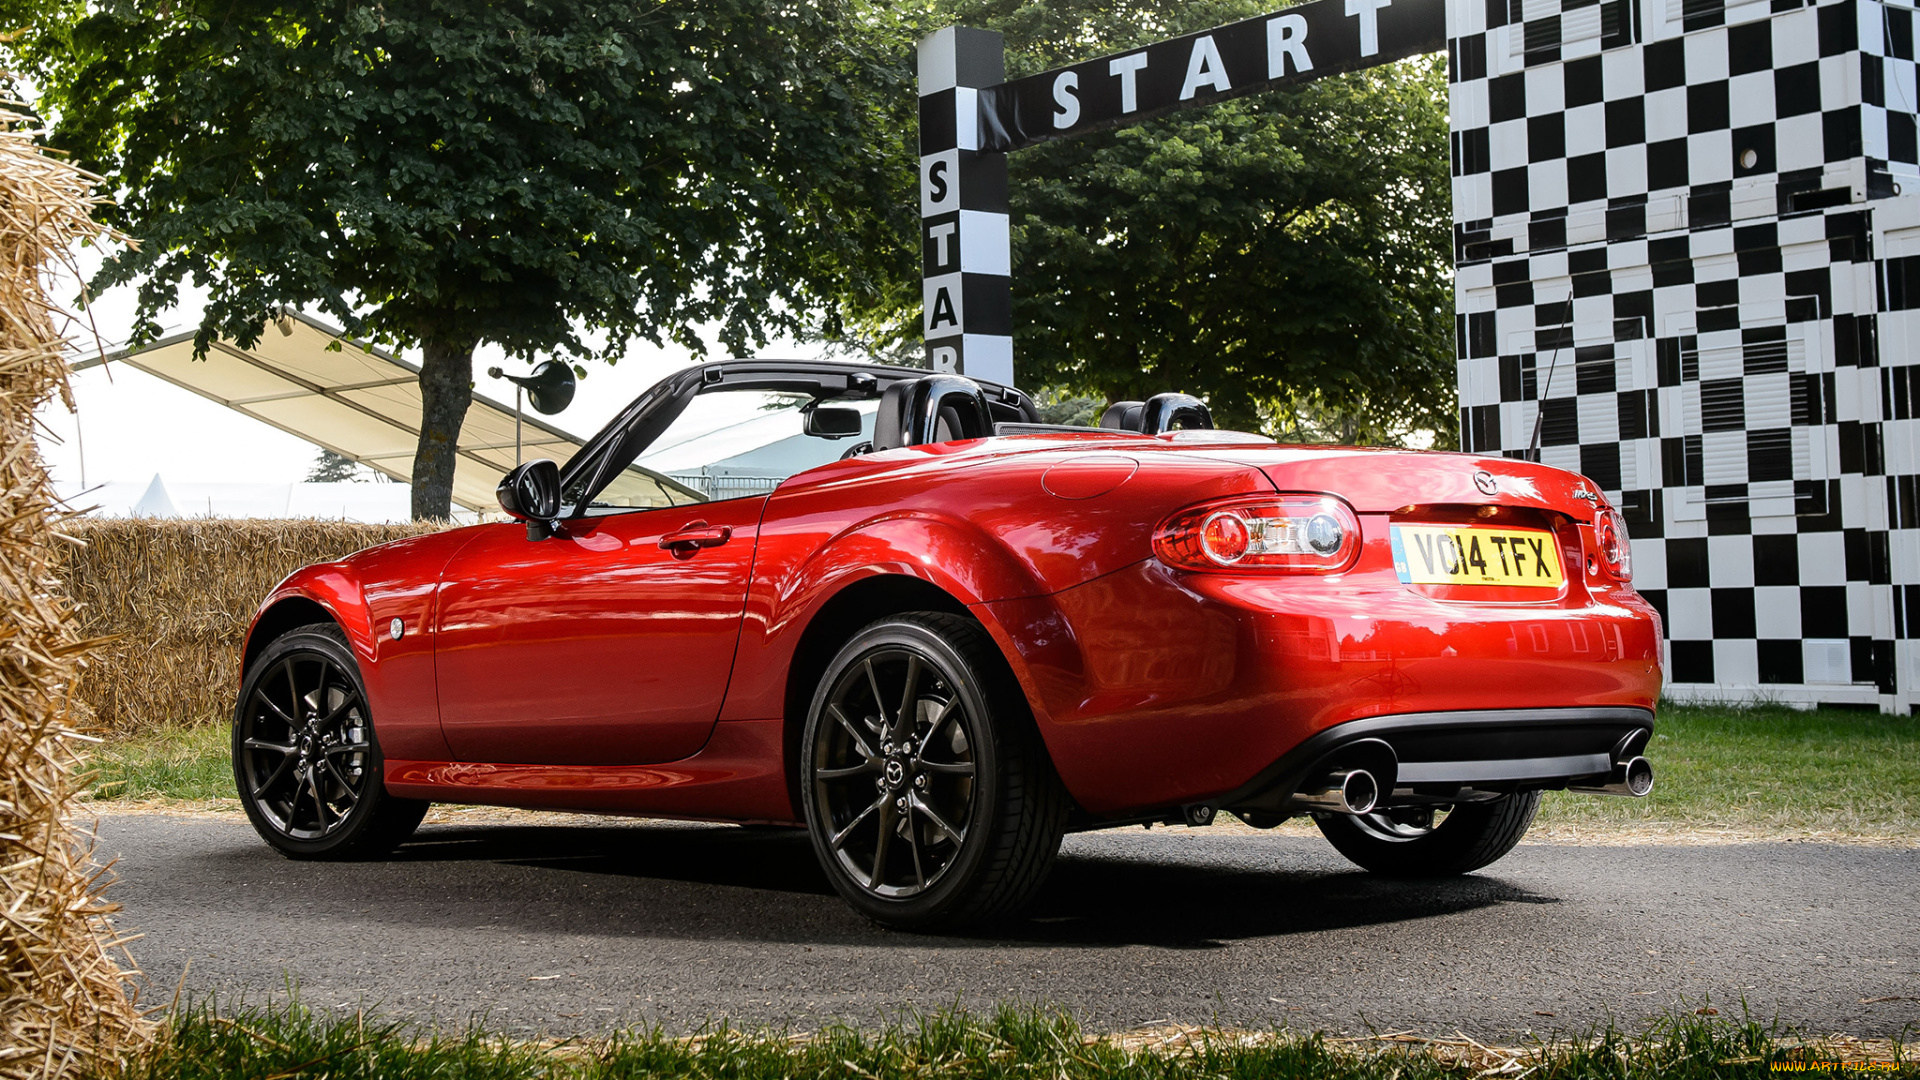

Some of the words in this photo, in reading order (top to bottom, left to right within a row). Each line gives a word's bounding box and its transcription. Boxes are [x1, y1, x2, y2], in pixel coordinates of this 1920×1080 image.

[1053, 0, 1392, 129] START
[929, 161, 958, 374] STAR
[1414, 534, 1487, 575] VO14
[1490, 536, 1552, 577] TFX
